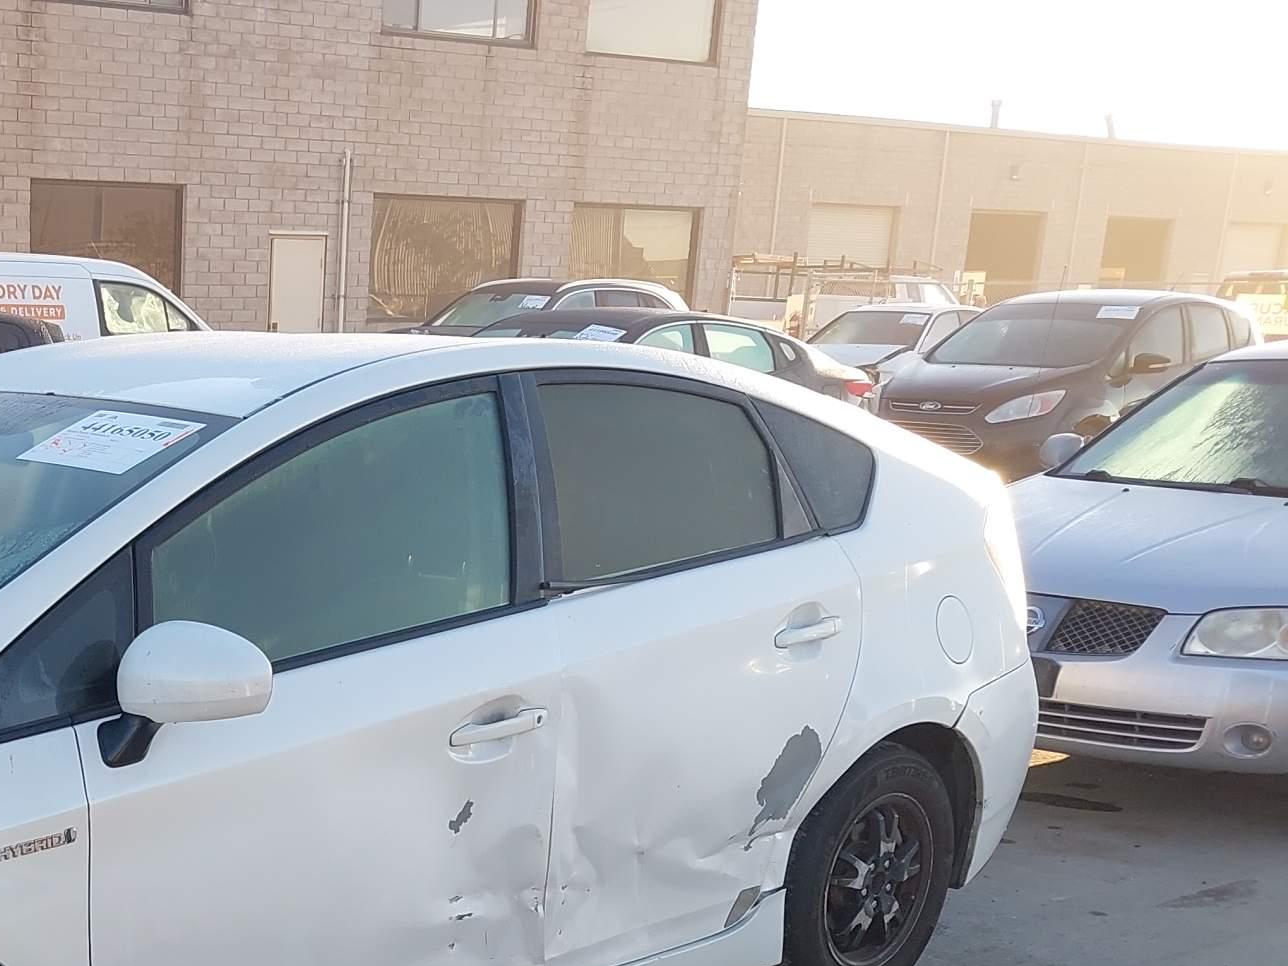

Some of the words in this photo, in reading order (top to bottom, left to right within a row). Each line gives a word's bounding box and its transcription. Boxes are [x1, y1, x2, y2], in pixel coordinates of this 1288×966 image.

[32, 285, 62, 301] DAY
[11, 306, 62, 317] DELIVERY
[81, 422, 172, 442] 44165050
